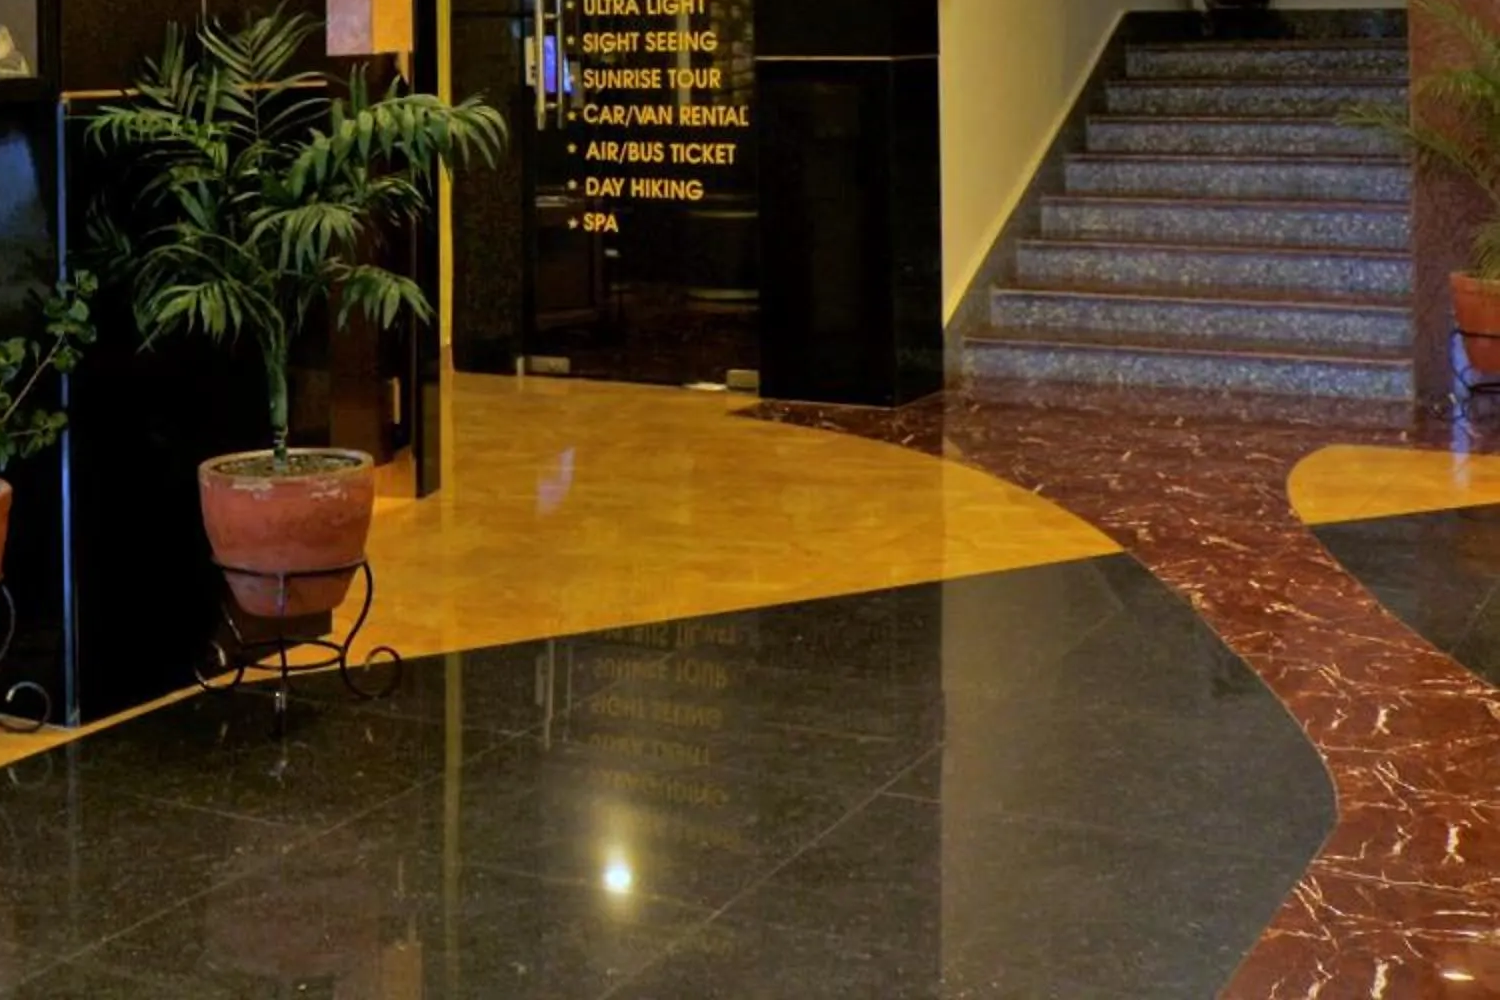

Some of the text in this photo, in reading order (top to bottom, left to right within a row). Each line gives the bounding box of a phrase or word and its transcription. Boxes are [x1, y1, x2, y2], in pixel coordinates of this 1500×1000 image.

[583, 31, 718, 53] SIGHT SEEING
[583, 68, 721, 90] SUNRISE TOUR
[583, 104, 749, 128] CAR/VAN RENTAL
[585, 141, 737, 165] AIR/BUS TICKET
[585, 177, 704, 200] DAY HIKING
[583, 212, 619, 232] SPA
